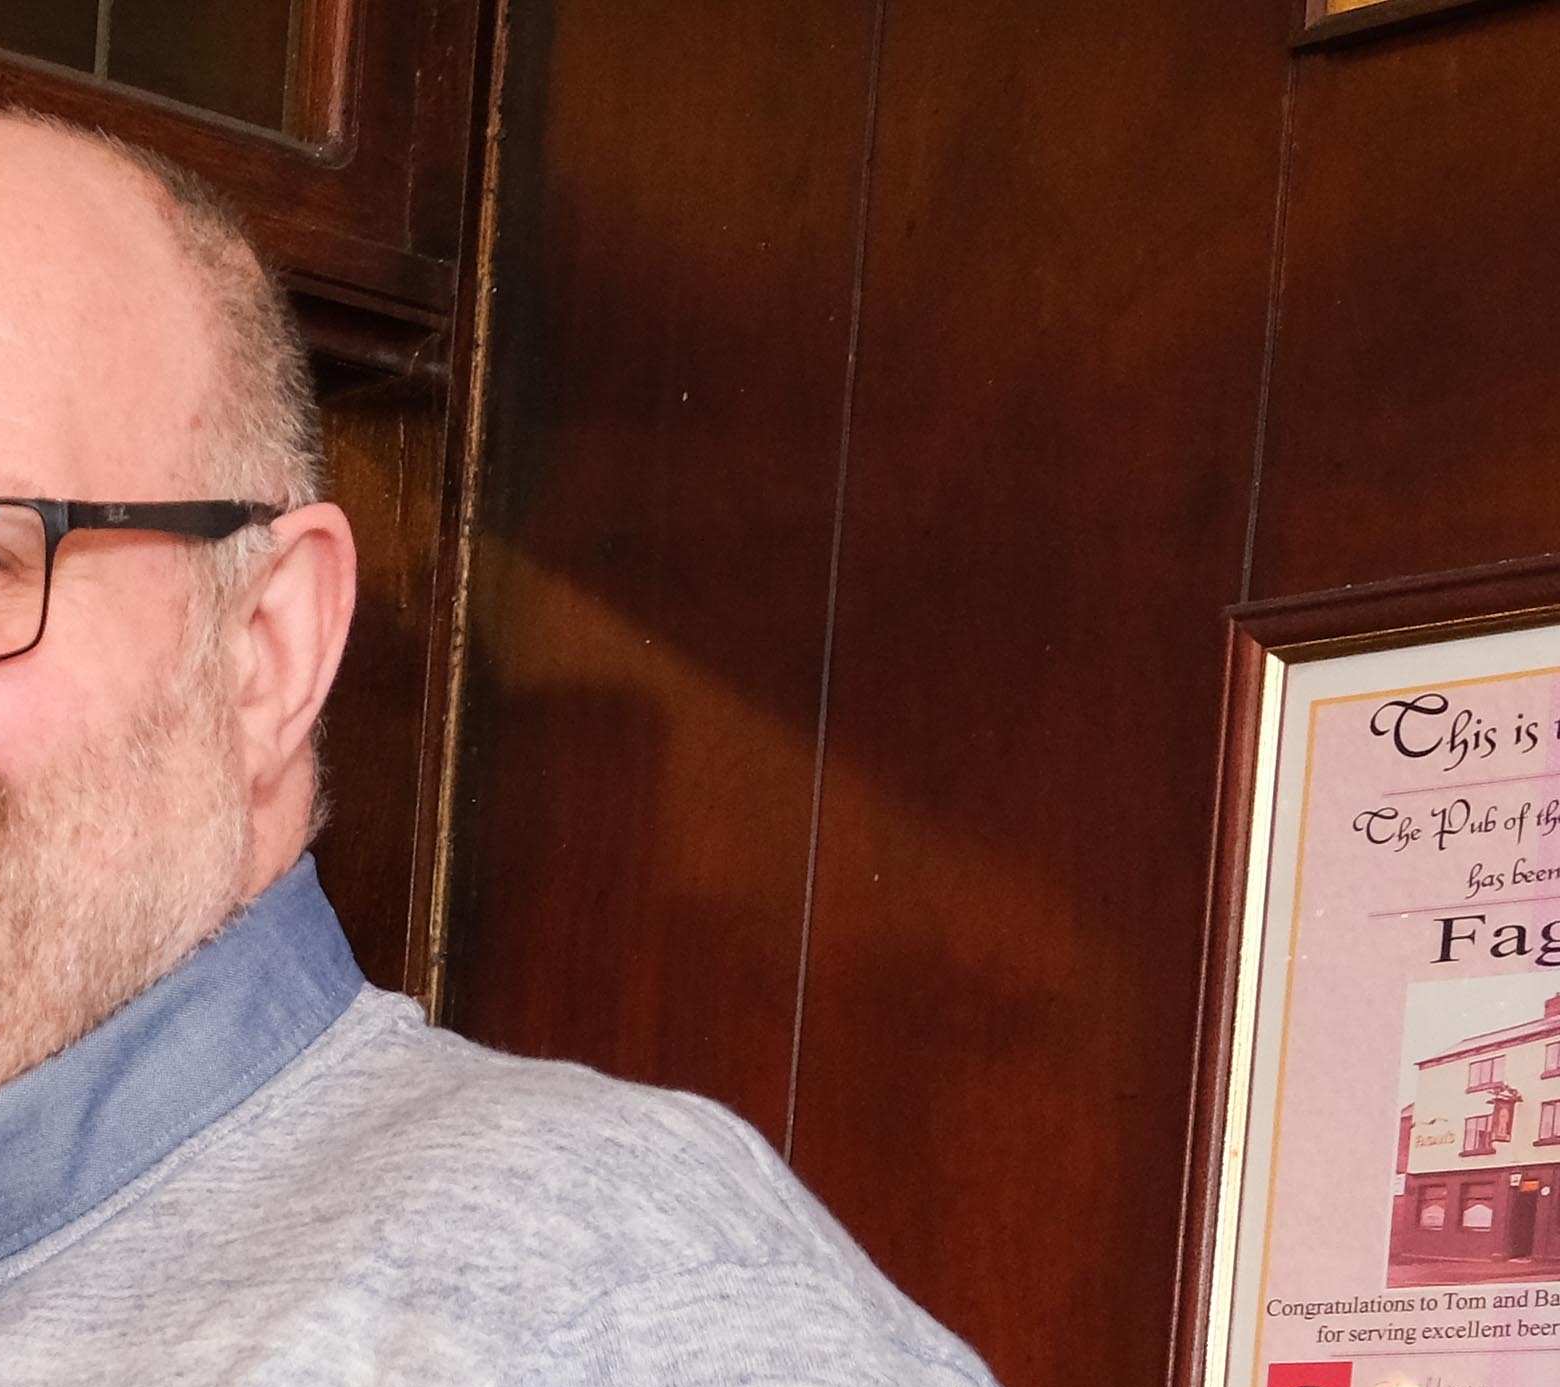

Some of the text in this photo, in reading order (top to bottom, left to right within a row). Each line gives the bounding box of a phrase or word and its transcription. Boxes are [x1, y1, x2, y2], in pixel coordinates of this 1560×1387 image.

[1369, 692, 1540, 772] This is
[1352, 798, 1560, 853] The Pub of th
[1464, 863, 1505, 900] has
[1266, 1288, 1560, 1320] Congratulations to Tom and Ba
[1315, 1325, 1344, 1344] for
[1348, 1325, 1418, 1346] serving
[1421, 1320, 1512, 1341] excellent
